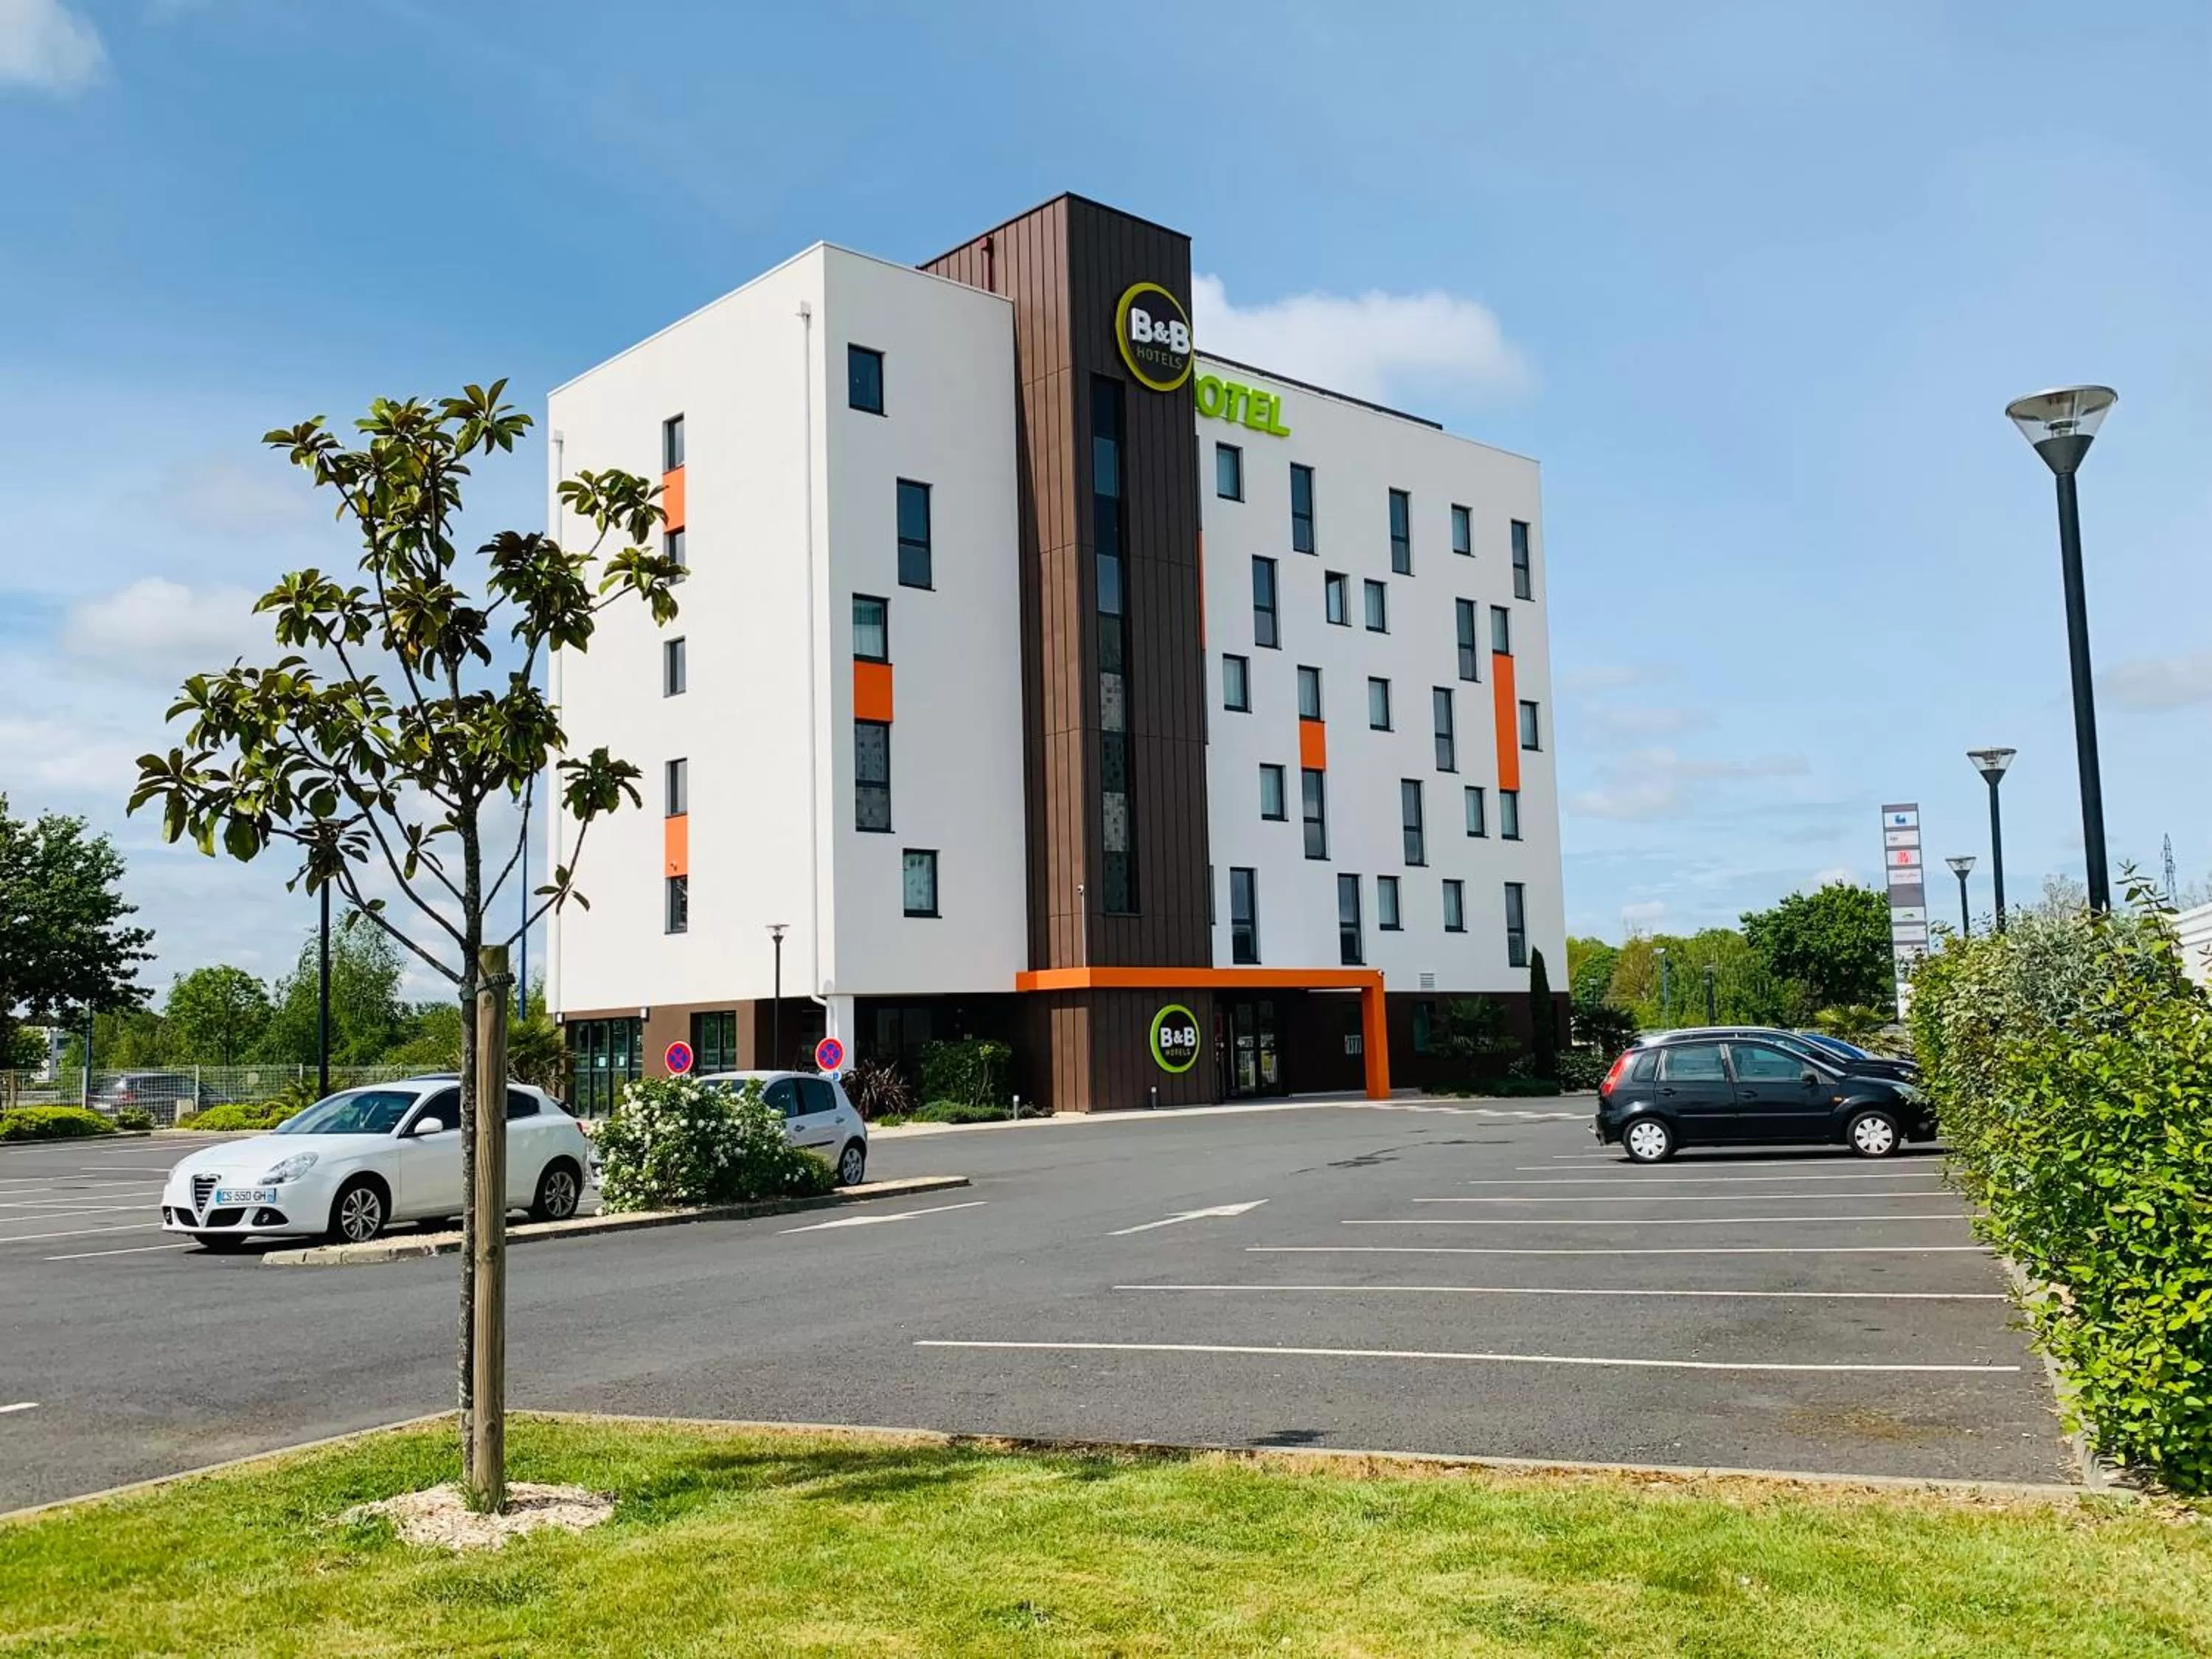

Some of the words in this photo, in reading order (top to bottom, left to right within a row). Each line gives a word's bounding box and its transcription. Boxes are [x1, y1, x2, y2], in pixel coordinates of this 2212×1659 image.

[1131, 307, 1191, 354] B&B
[1136, 346, 1183, 369] HOTELS
[1195, 375, 1291, 437] OTEL
[1161, 1027, 1195, 1047] B&B
